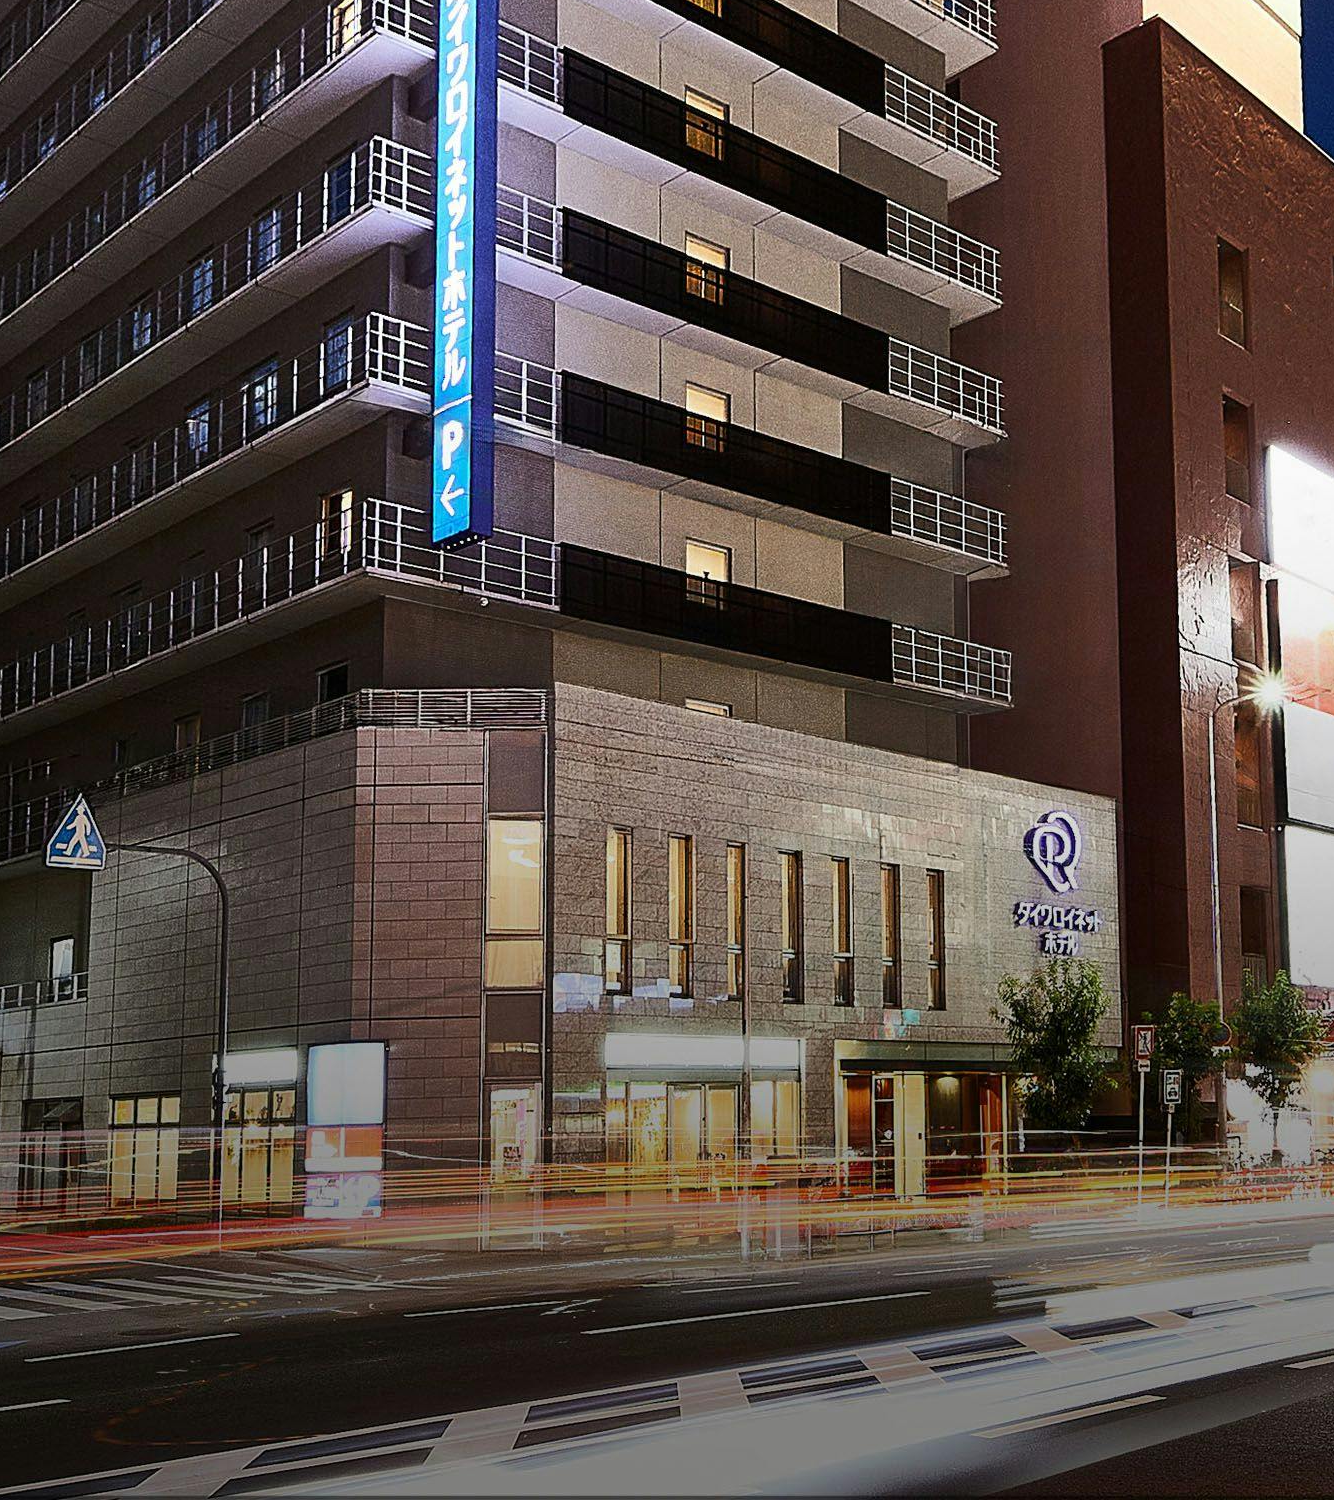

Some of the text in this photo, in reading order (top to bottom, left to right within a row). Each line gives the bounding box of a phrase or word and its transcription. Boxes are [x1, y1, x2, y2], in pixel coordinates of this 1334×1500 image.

[441, 419, 464, 471] P
[1017, 901, 1103, 933] ダイワロイネット
[1044, 931, 1080, 956] ホテル
